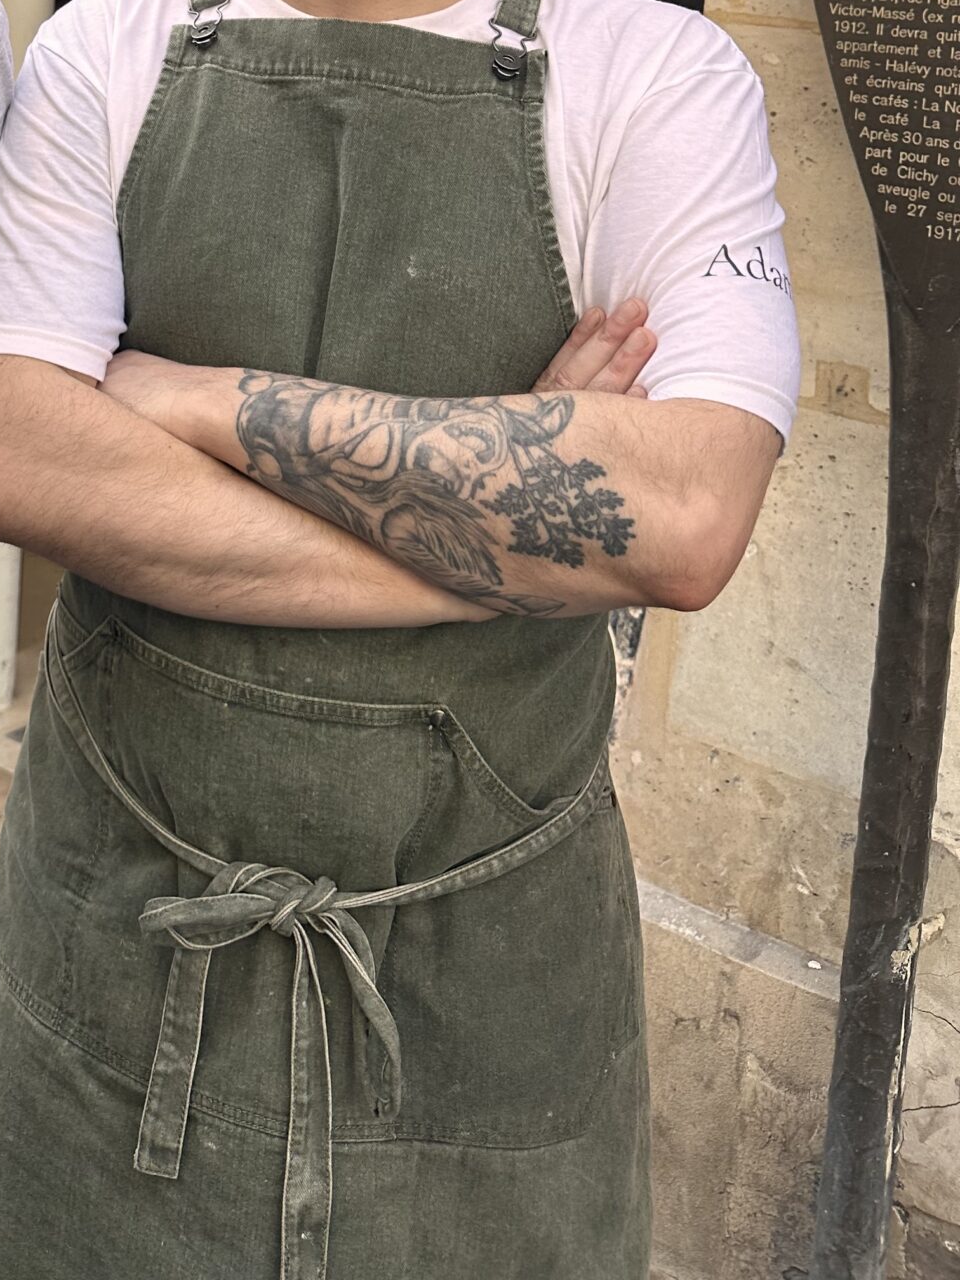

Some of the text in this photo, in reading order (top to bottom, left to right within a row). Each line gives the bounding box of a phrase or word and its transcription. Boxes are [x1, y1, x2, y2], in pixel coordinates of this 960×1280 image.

[829, 2, 915, 20] Victor-Massé
[834, 20, 869, 35] 1912.
[891, 25, 928, 40] devra
[836, 39, 919, 56] appartement
[927, 46, 941, 59] et
[840, 56, 870, 70] amis
[885, 59, 931, 78] Halévy
[844, 73, 858, 86] et
[866, 75, 925, 92] écrivains
[849, 90, 868, 104] les
[872, 94, 909, 108] cafés
[921, 97, 939, 112] La
[854, 108, 866, 121] le
[879, 111, 909, 126] café
[922, 115, 940, 130] La
[859, 126, 899, 143] Après
[901, 130, 922, 145] 30
[925, 136, 950, 149] ans
[865, 147, 891, 160] part
[899, 151, 930, 164] pour
[937, 152, 950, 167] le
[871, 162, 888, 176] de
[897, 165, 939, 186] Clichy
[937, 192, 955, 203] ou
[884, 200, 897, 213] le
[907, 203, 927, 218] 27
